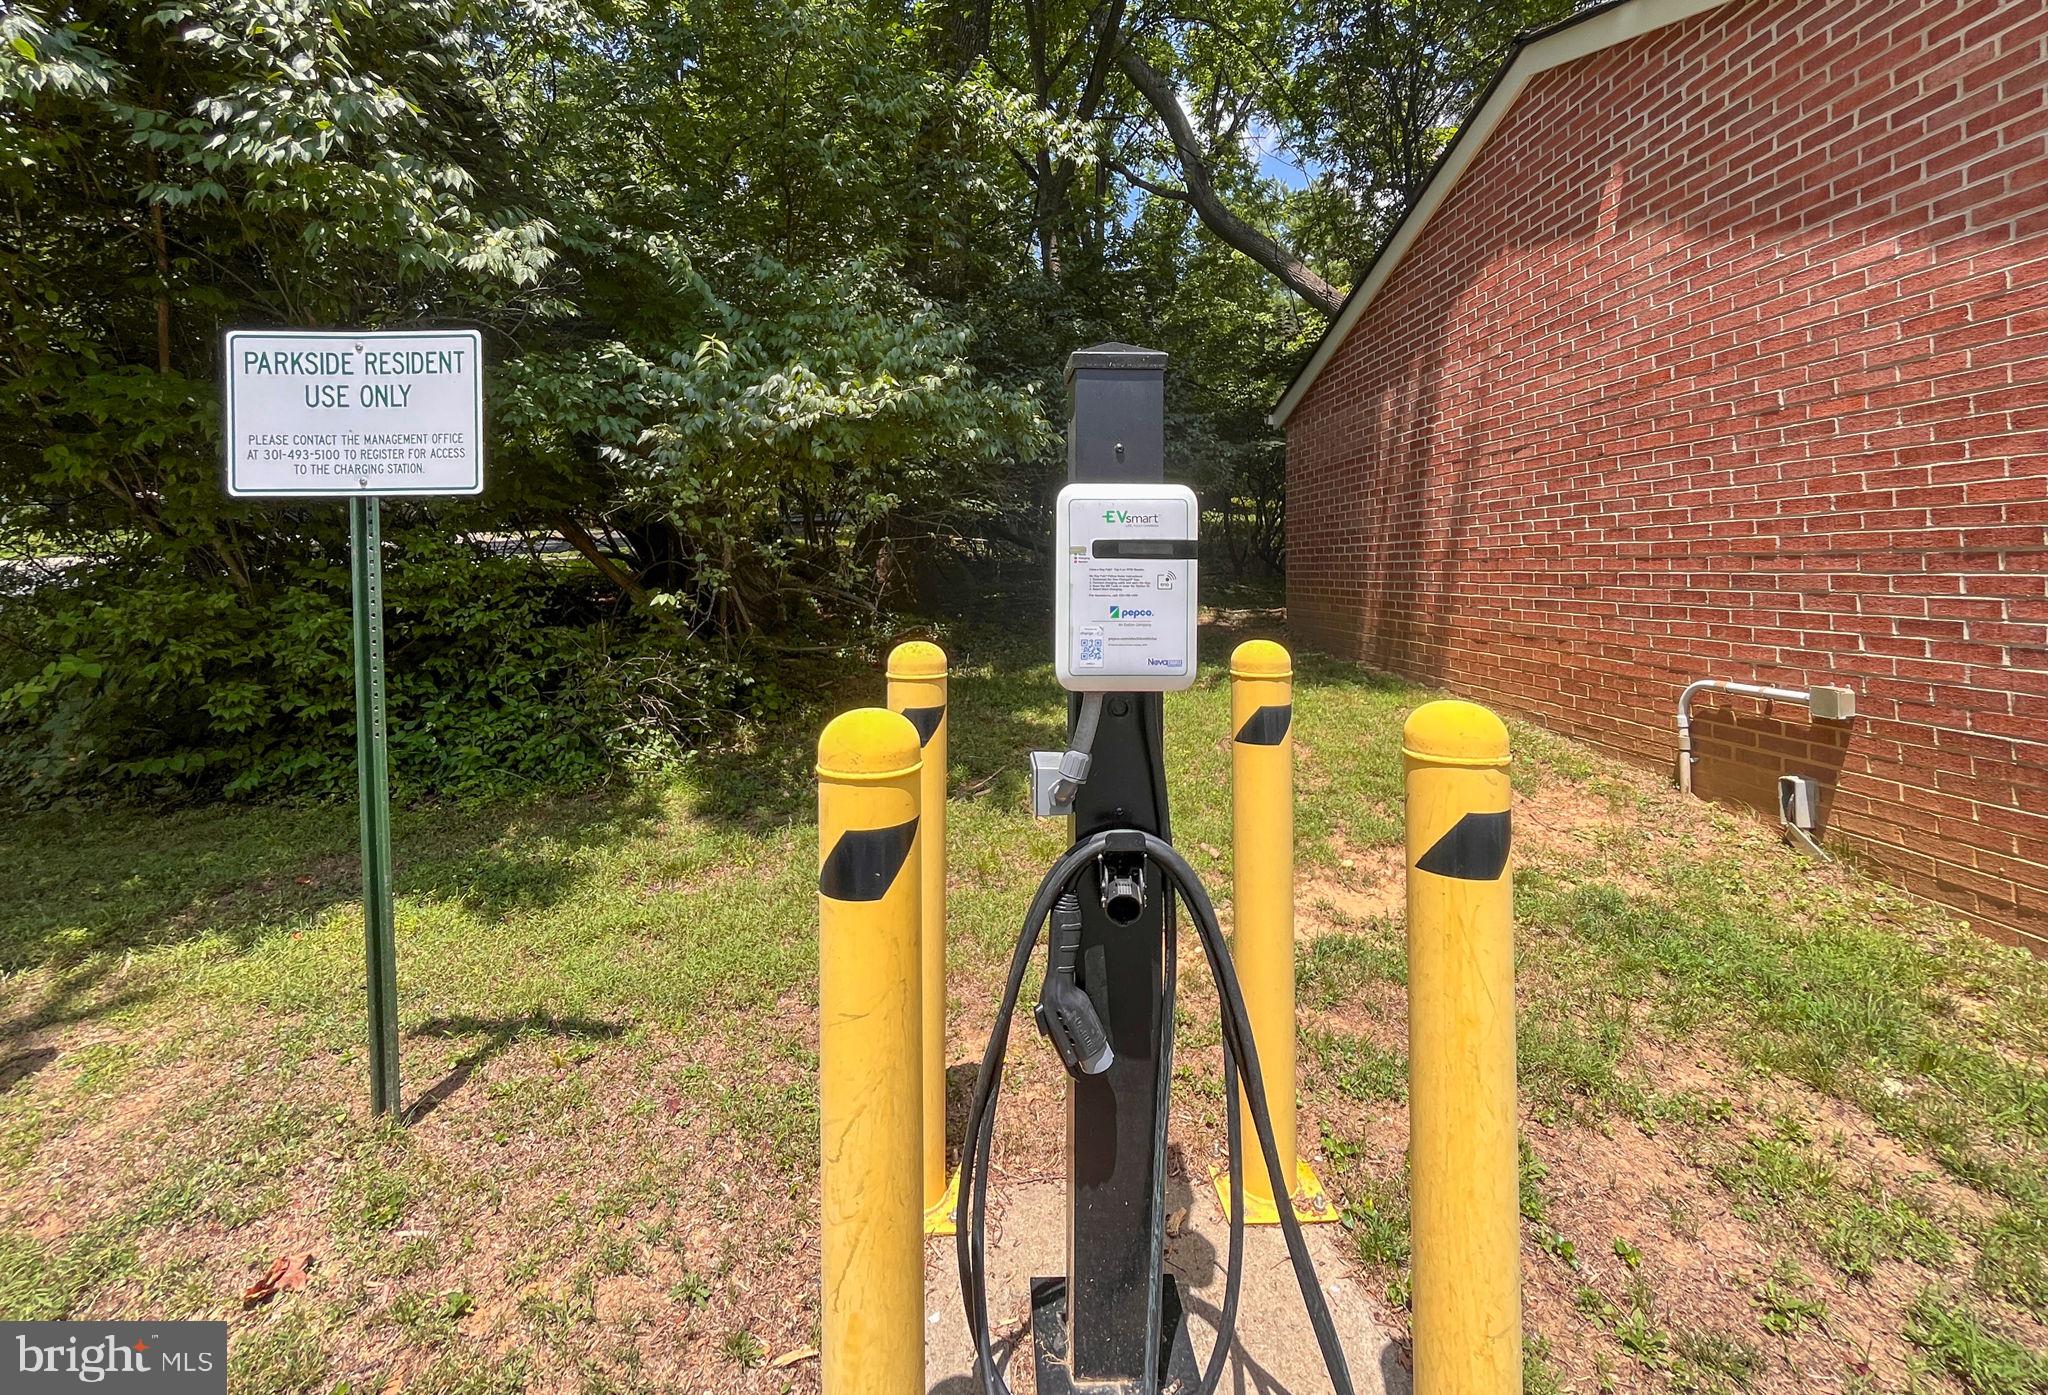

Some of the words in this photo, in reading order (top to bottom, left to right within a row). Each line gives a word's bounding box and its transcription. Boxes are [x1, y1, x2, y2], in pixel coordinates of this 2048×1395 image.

[245, 352, 354, 375] PARKSIDE
[365, 351, 464, 375] RESIDENT
[306, 385, 349, 408] USE
[360, 384, 411, 408] ONLY
[249, 435, 288, 445] PLEASE
[293, 435, 337, 445] CONTACT
[341, 435, 360, 445] THE
[364, 434, 428, 445] MANAGEMENT
[432, 433, 463, 444] OFFICE
[247, 450, 259, 460] AT
[264, 450, 339, 460] 301-493-5100
[344, 450, 356, 460] TO
[361, 449, 404, 460] REGISTER
[408, 448, 426, 459] FOR
[430, 448, 465, 458] ACCESS
[294, 464, 307, 474] TO
[311, 464, 330, 474] THE
[334, 464, 384, 474] CHARGING
[388, 463, 425, 474] STATION.
